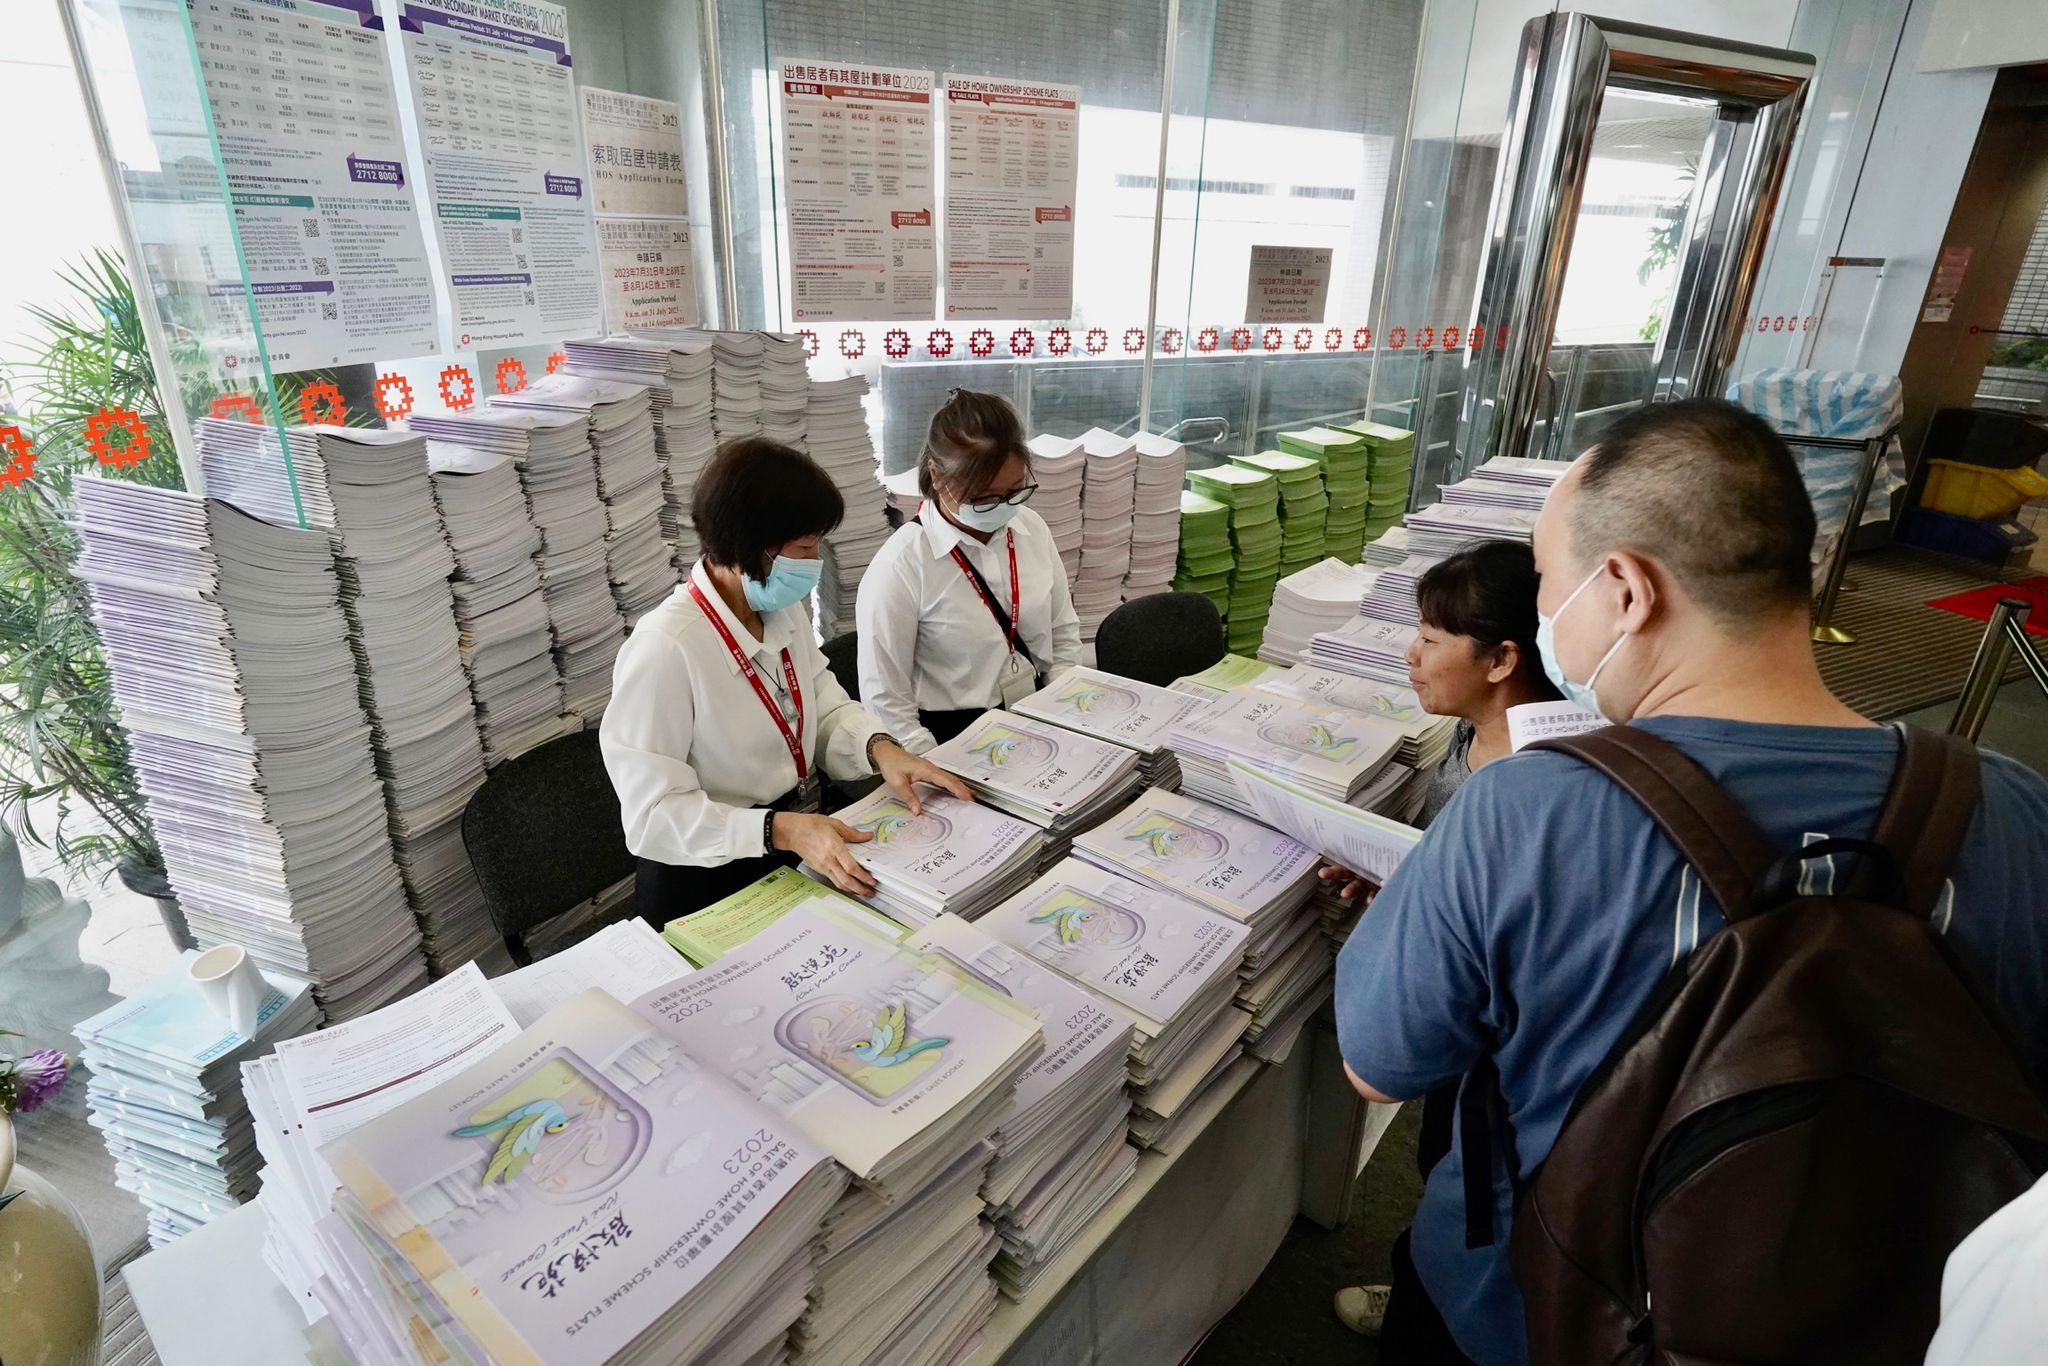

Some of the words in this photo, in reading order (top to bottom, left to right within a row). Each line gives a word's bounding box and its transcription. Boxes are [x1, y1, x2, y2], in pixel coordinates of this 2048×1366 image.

[948, 80, 961, 90] SALE
[962, 81, 971, 90] OF
[971, 82, 988, 92] HOME
[989, 83, 1021, 95] OWNERSHIP
[1023, 86, 1044, 97] SCHEME
[1045, 88, 1059, 98] FLATS
[662, 114, 679, 127] 2023
[592, 144, 682, 172] 索取居屋申請表
[356, 170, 377, 180] 2712
[378, 171, 398, 181] 8000
[596, 171, 613, 179] HOS
[619, 172, 661, 184] Application
[665, 176, 683, 185] Form
[549, 184, 564, 192] 2712
[564, 185, 578, 193] 8000
[673, 232, 689, 243] 2023
[637, 252, 663, 262] 申請日期
[632, 297, 660, 306] Application
[1555, 725, 1580, 734] HOME
[1193, 920, 1217, 940] 2023
[658, 1001, 679, 1015] SALE
[680, 995, 693, 1007] OF
[693, 983, 718, 999] HOME
[718, 961, 763, 987] OWNERSHIP
[763, 942, 792, 964] SCHEME
[791, 929, 813, 945] FLATS
[838, 951, 864, 973] Court
[668, 999, 713, 1024] 2023
[1065, 1004, 1096, 1030] 2023
[1091, 1012, 1106, 1025] SALE
[1065, 1030, 1084, 1047] HOME
[1083, 1023, 1092, 1032] OF
[1032, 1045, 1066, 1074] OWNERSHIP
[487, 1072, 509, 1091] SALES
[449, 1089, 486, 1112] BOOKLET
[723, 1128, 774, 1174] 2023
[761, 1140, 786, 1162] SALE
[748, 1162, 763, 1178] OF
[715, 1176, 749, 1209] HOME
[591, 1191, 618, 1219] Kai
[673, 1148, 799, 1269] 出售居者有其屋計劃單位
[654, 1208, 716, 1269] OWNERSHIP
[500, 1243, 548, 1283] Court
[602, 1266, 652, 1309] SCHEME
[566, 1305, 603, 1337] FLATS
